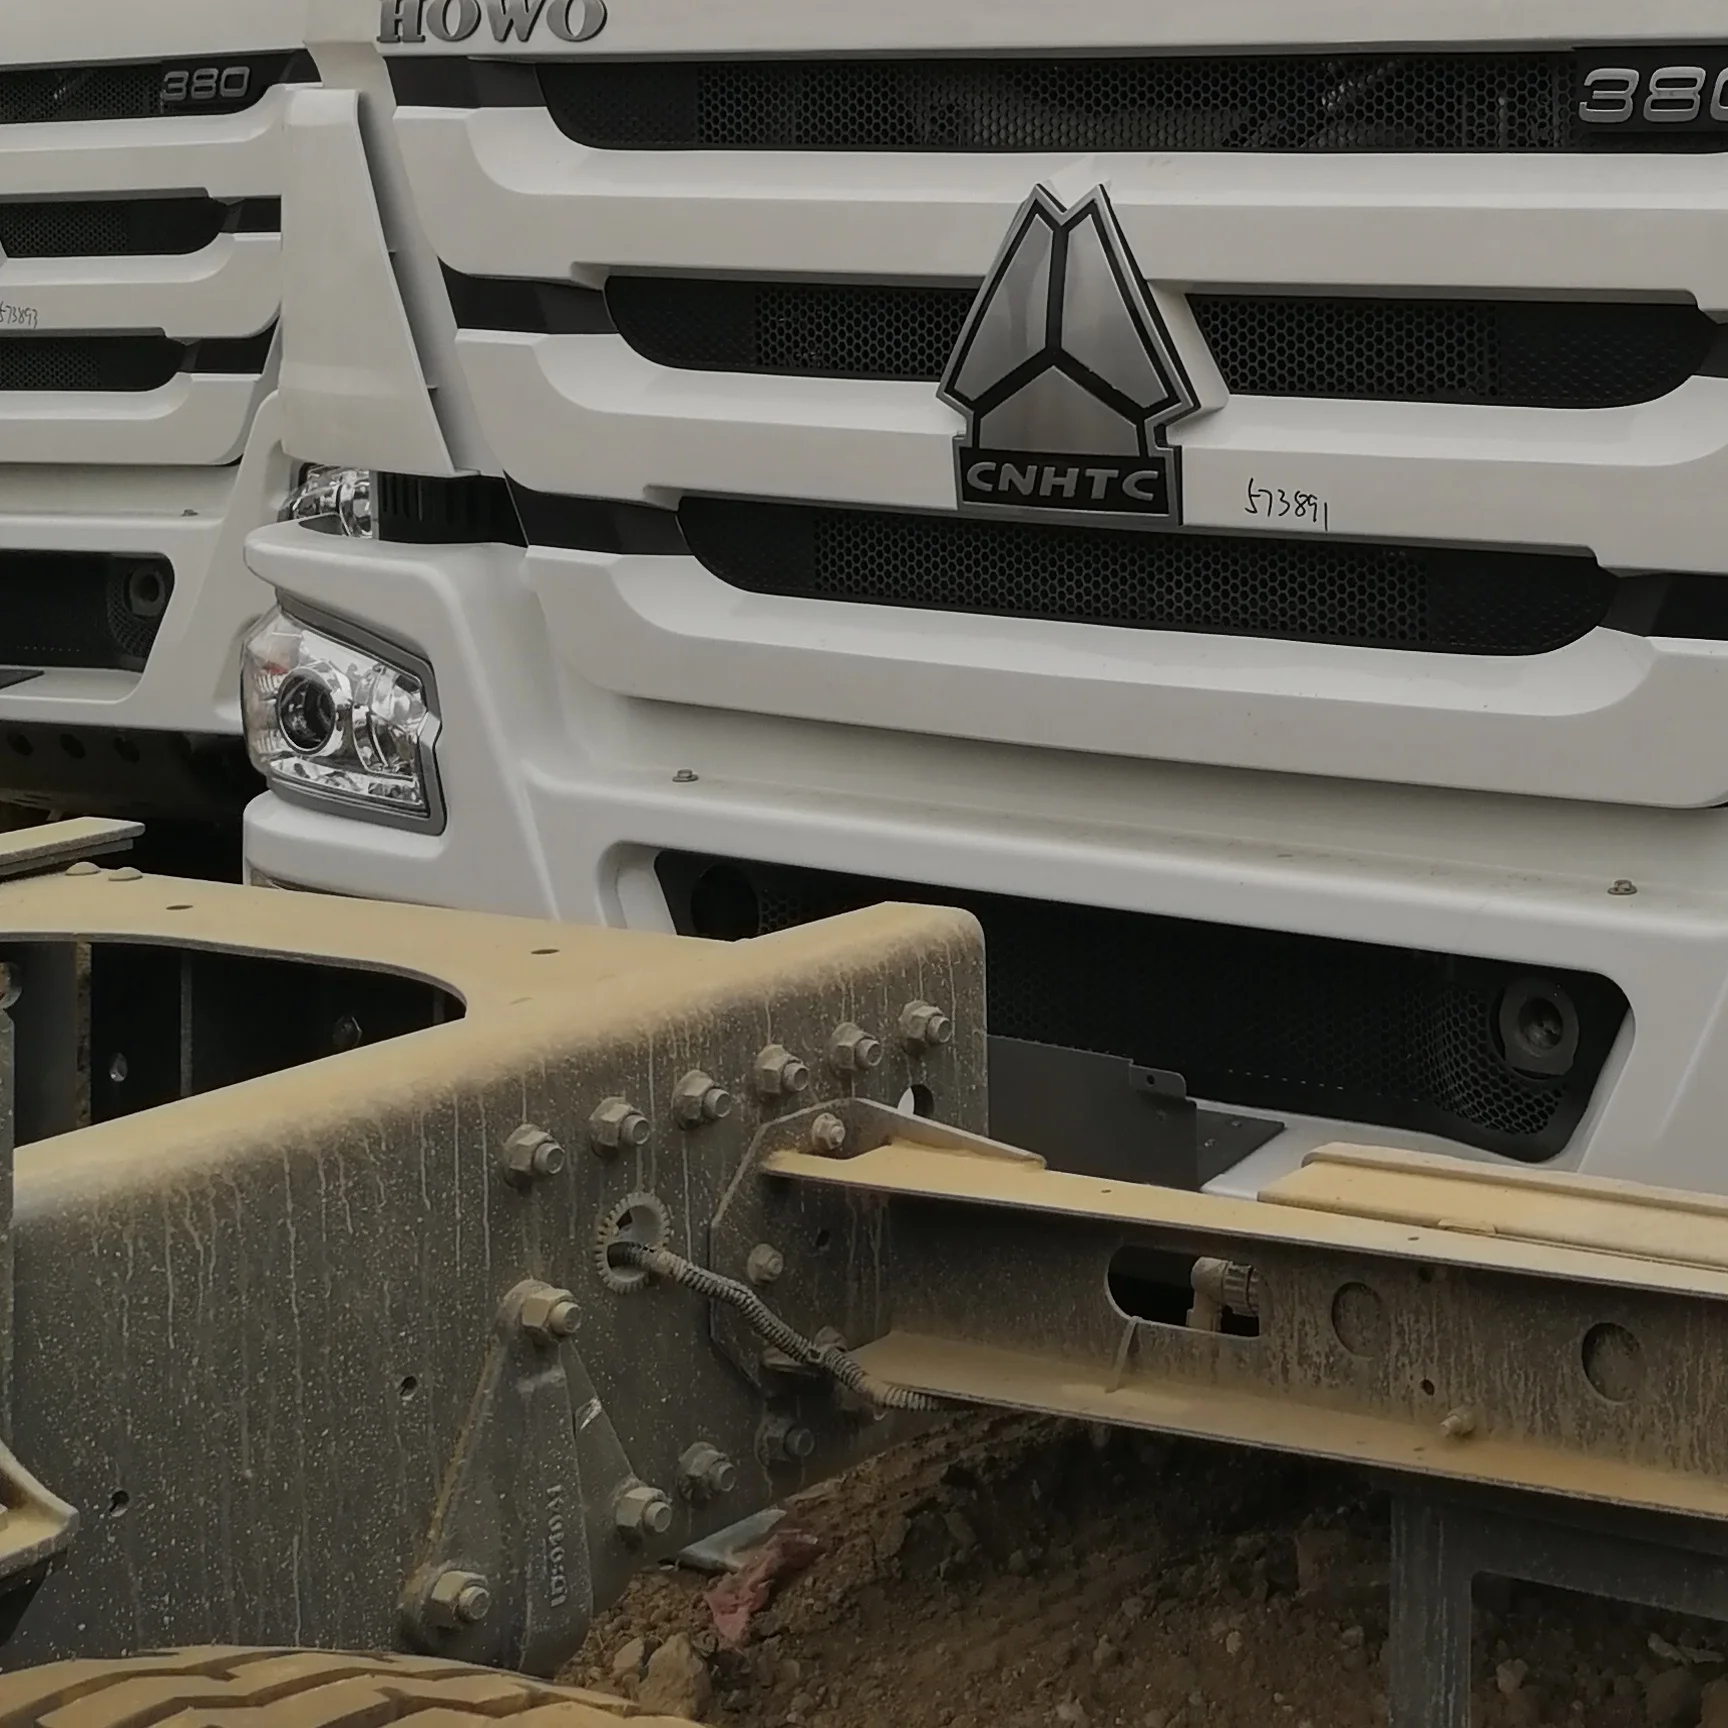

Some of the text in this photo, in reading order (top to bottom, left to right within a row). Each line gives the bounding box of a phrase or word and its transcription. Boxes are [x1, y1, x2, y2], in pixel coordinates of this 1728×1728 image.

[162, 66, 251, 101] 380
[966, 461, 1159, 502] CNHTC
[1244, 477, 1328, 532] 573891
